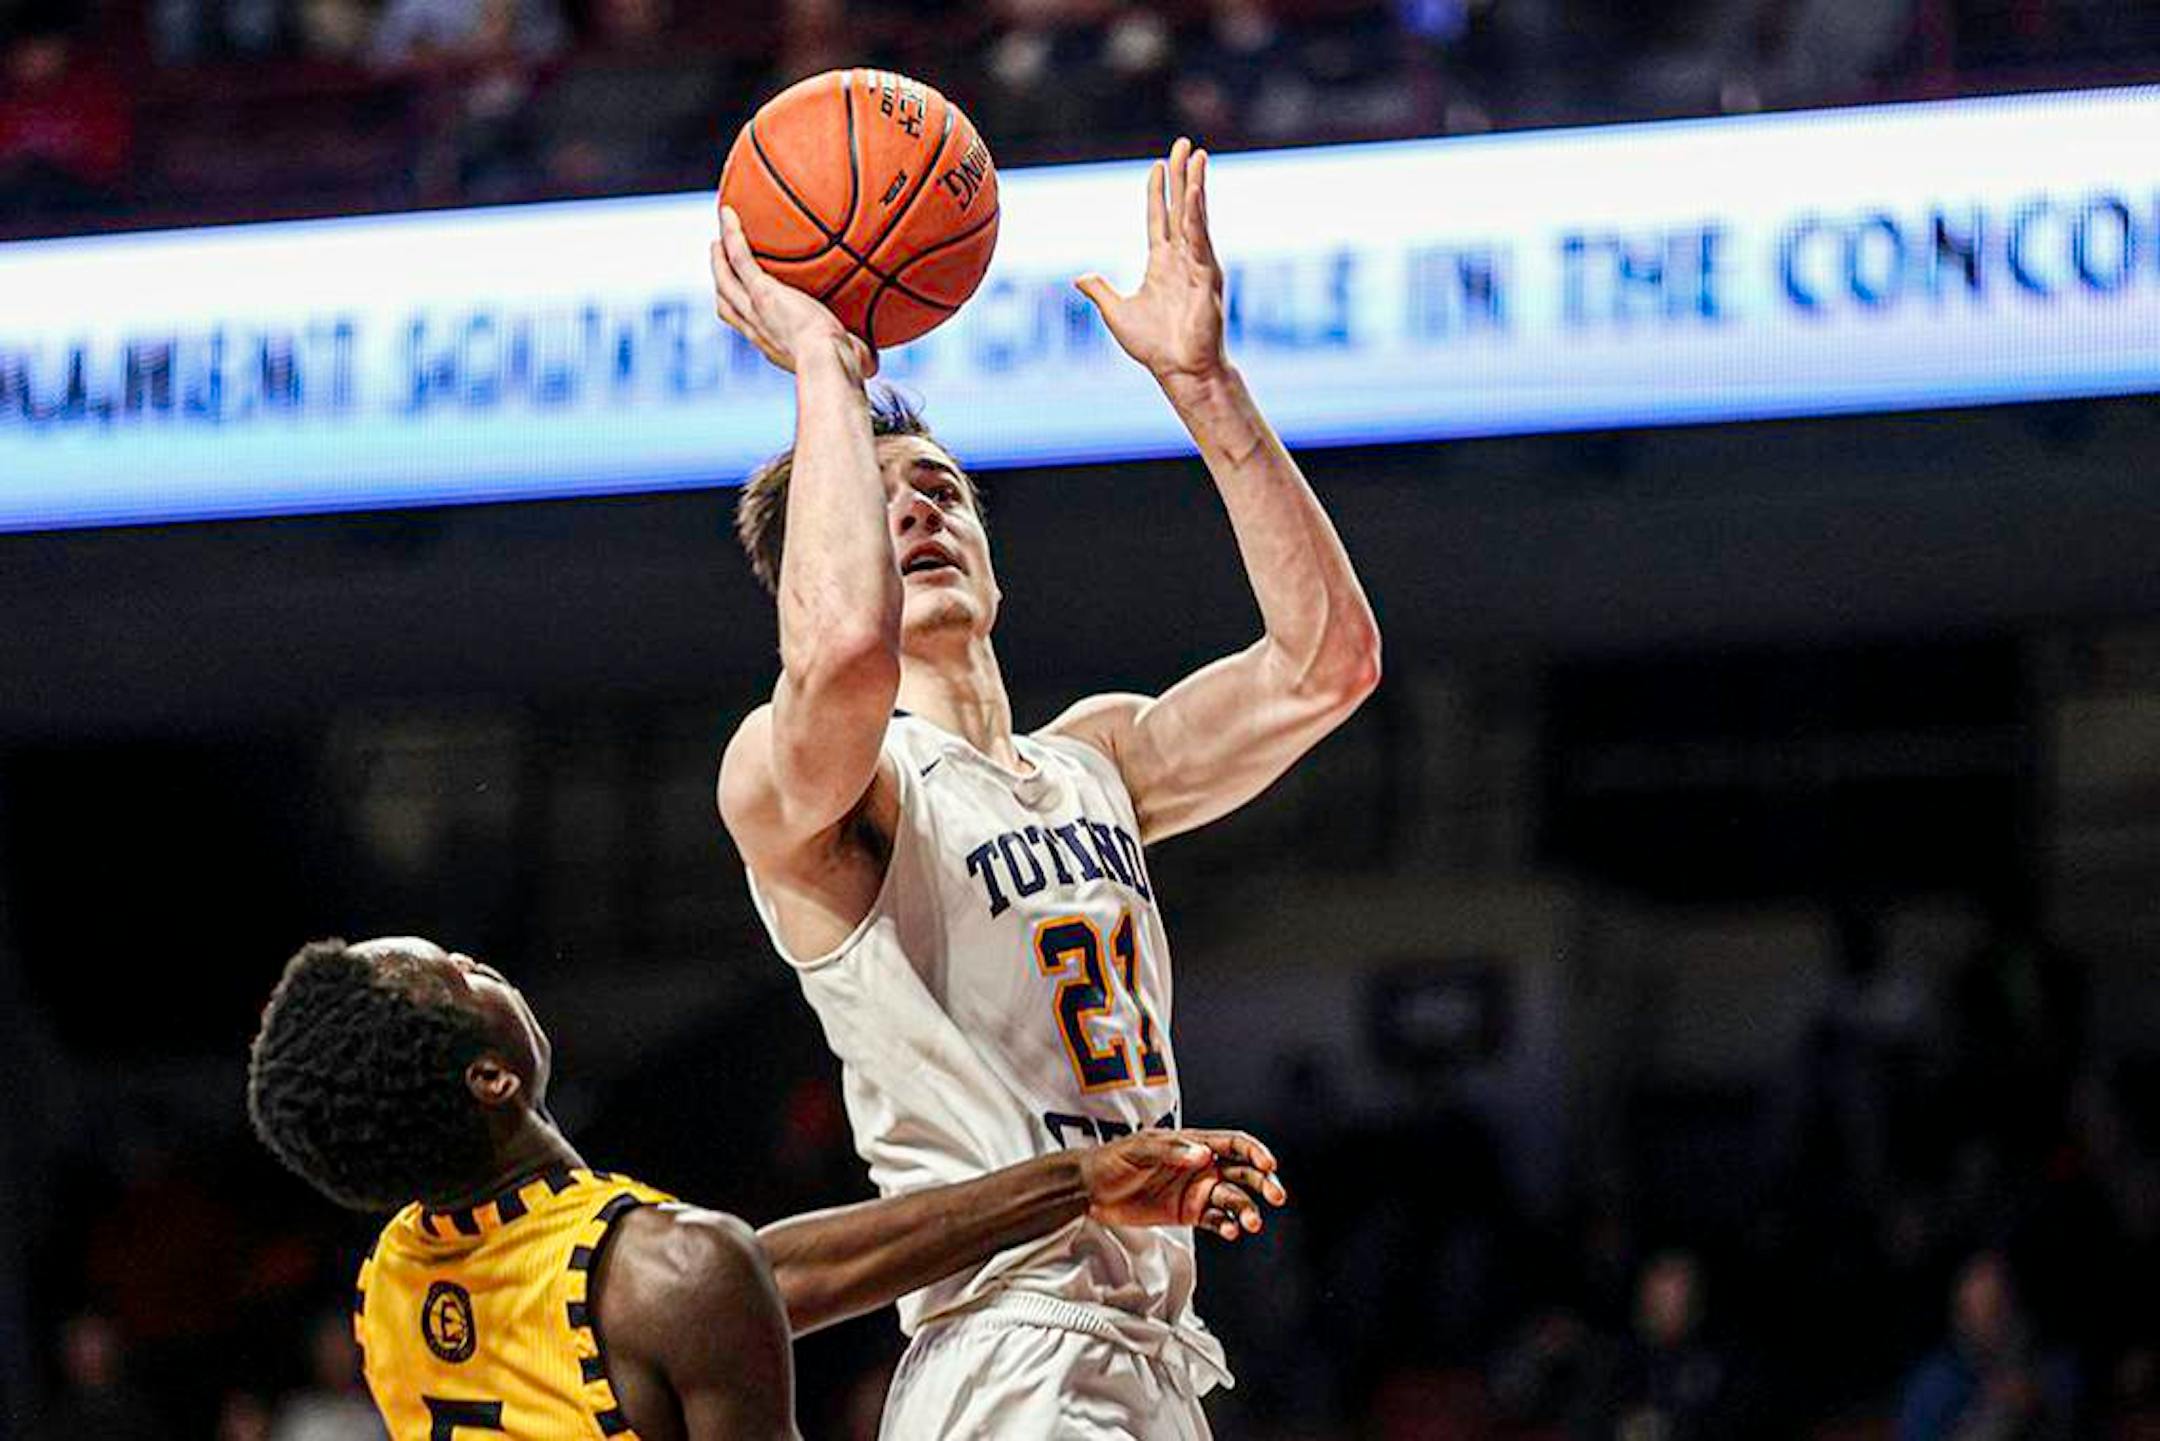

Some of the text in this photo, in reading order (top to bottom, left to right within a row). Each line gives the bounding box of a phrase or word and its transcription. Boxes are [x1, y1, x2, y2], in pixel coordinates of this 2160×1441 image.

[1560, 222, 1728, 324] THE
[1778, 186, 2160, 314] CONCO
[966, 816, 1150, 920] TOTINO
[1033, 905, 1171, 1096] 21
